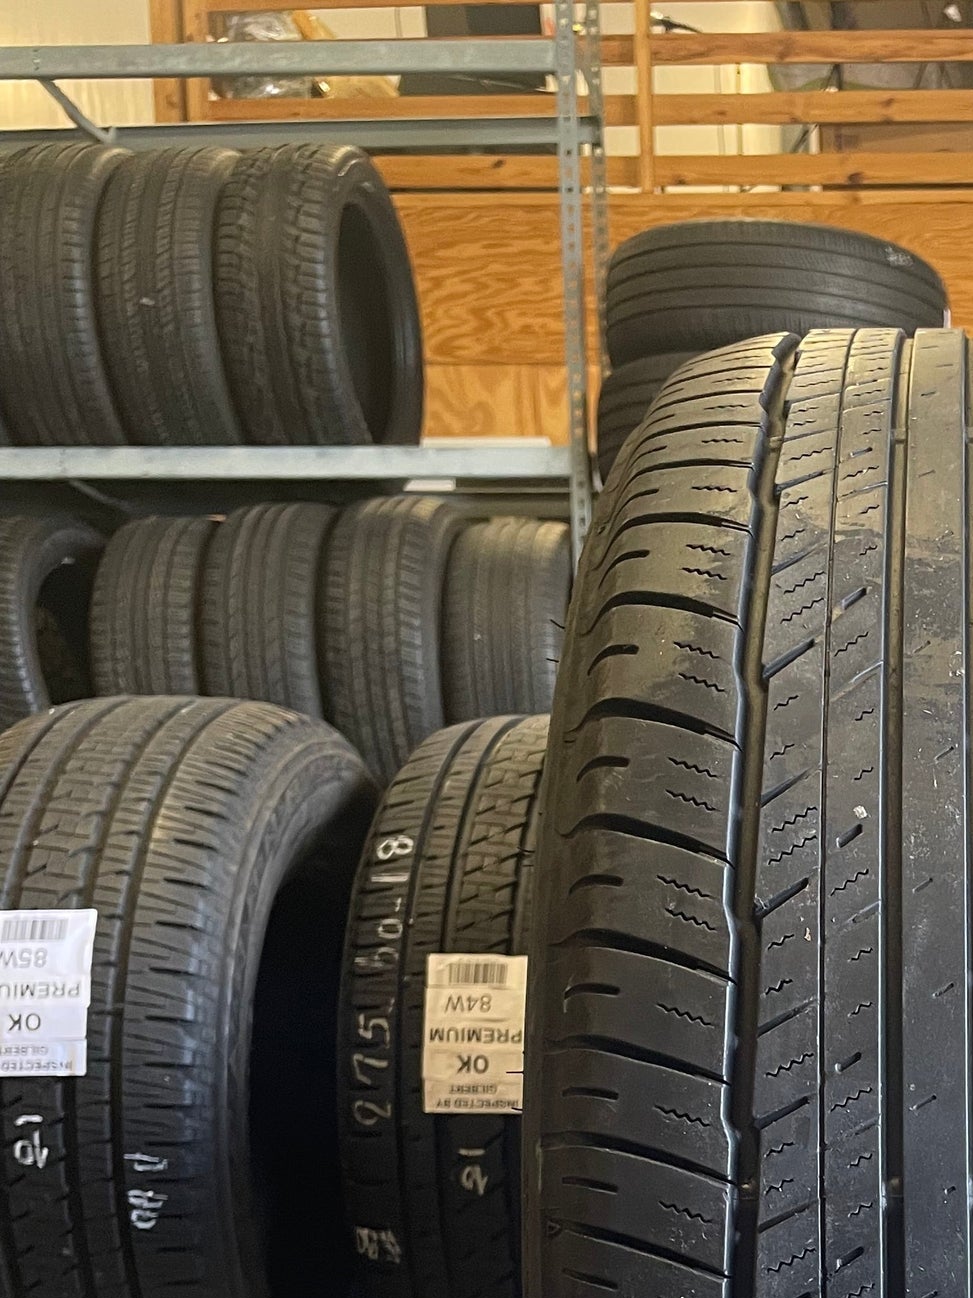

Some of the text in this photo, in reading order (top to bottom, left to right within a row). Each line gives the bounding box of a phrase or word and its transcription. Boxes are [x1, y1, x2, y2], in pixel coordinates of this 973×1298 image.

[0, 948, 48, 969] 85W
[0, 981, 82, 999] PREMIU
[444, 993, 493, 1014] 84W
[8, 1013, 42, 1032] OK
[429, 1027, 523, 1044] PREMIUM
[456, 1054, 490, 1074] OK
[449, 1083, 498, 1095] GILBERT
